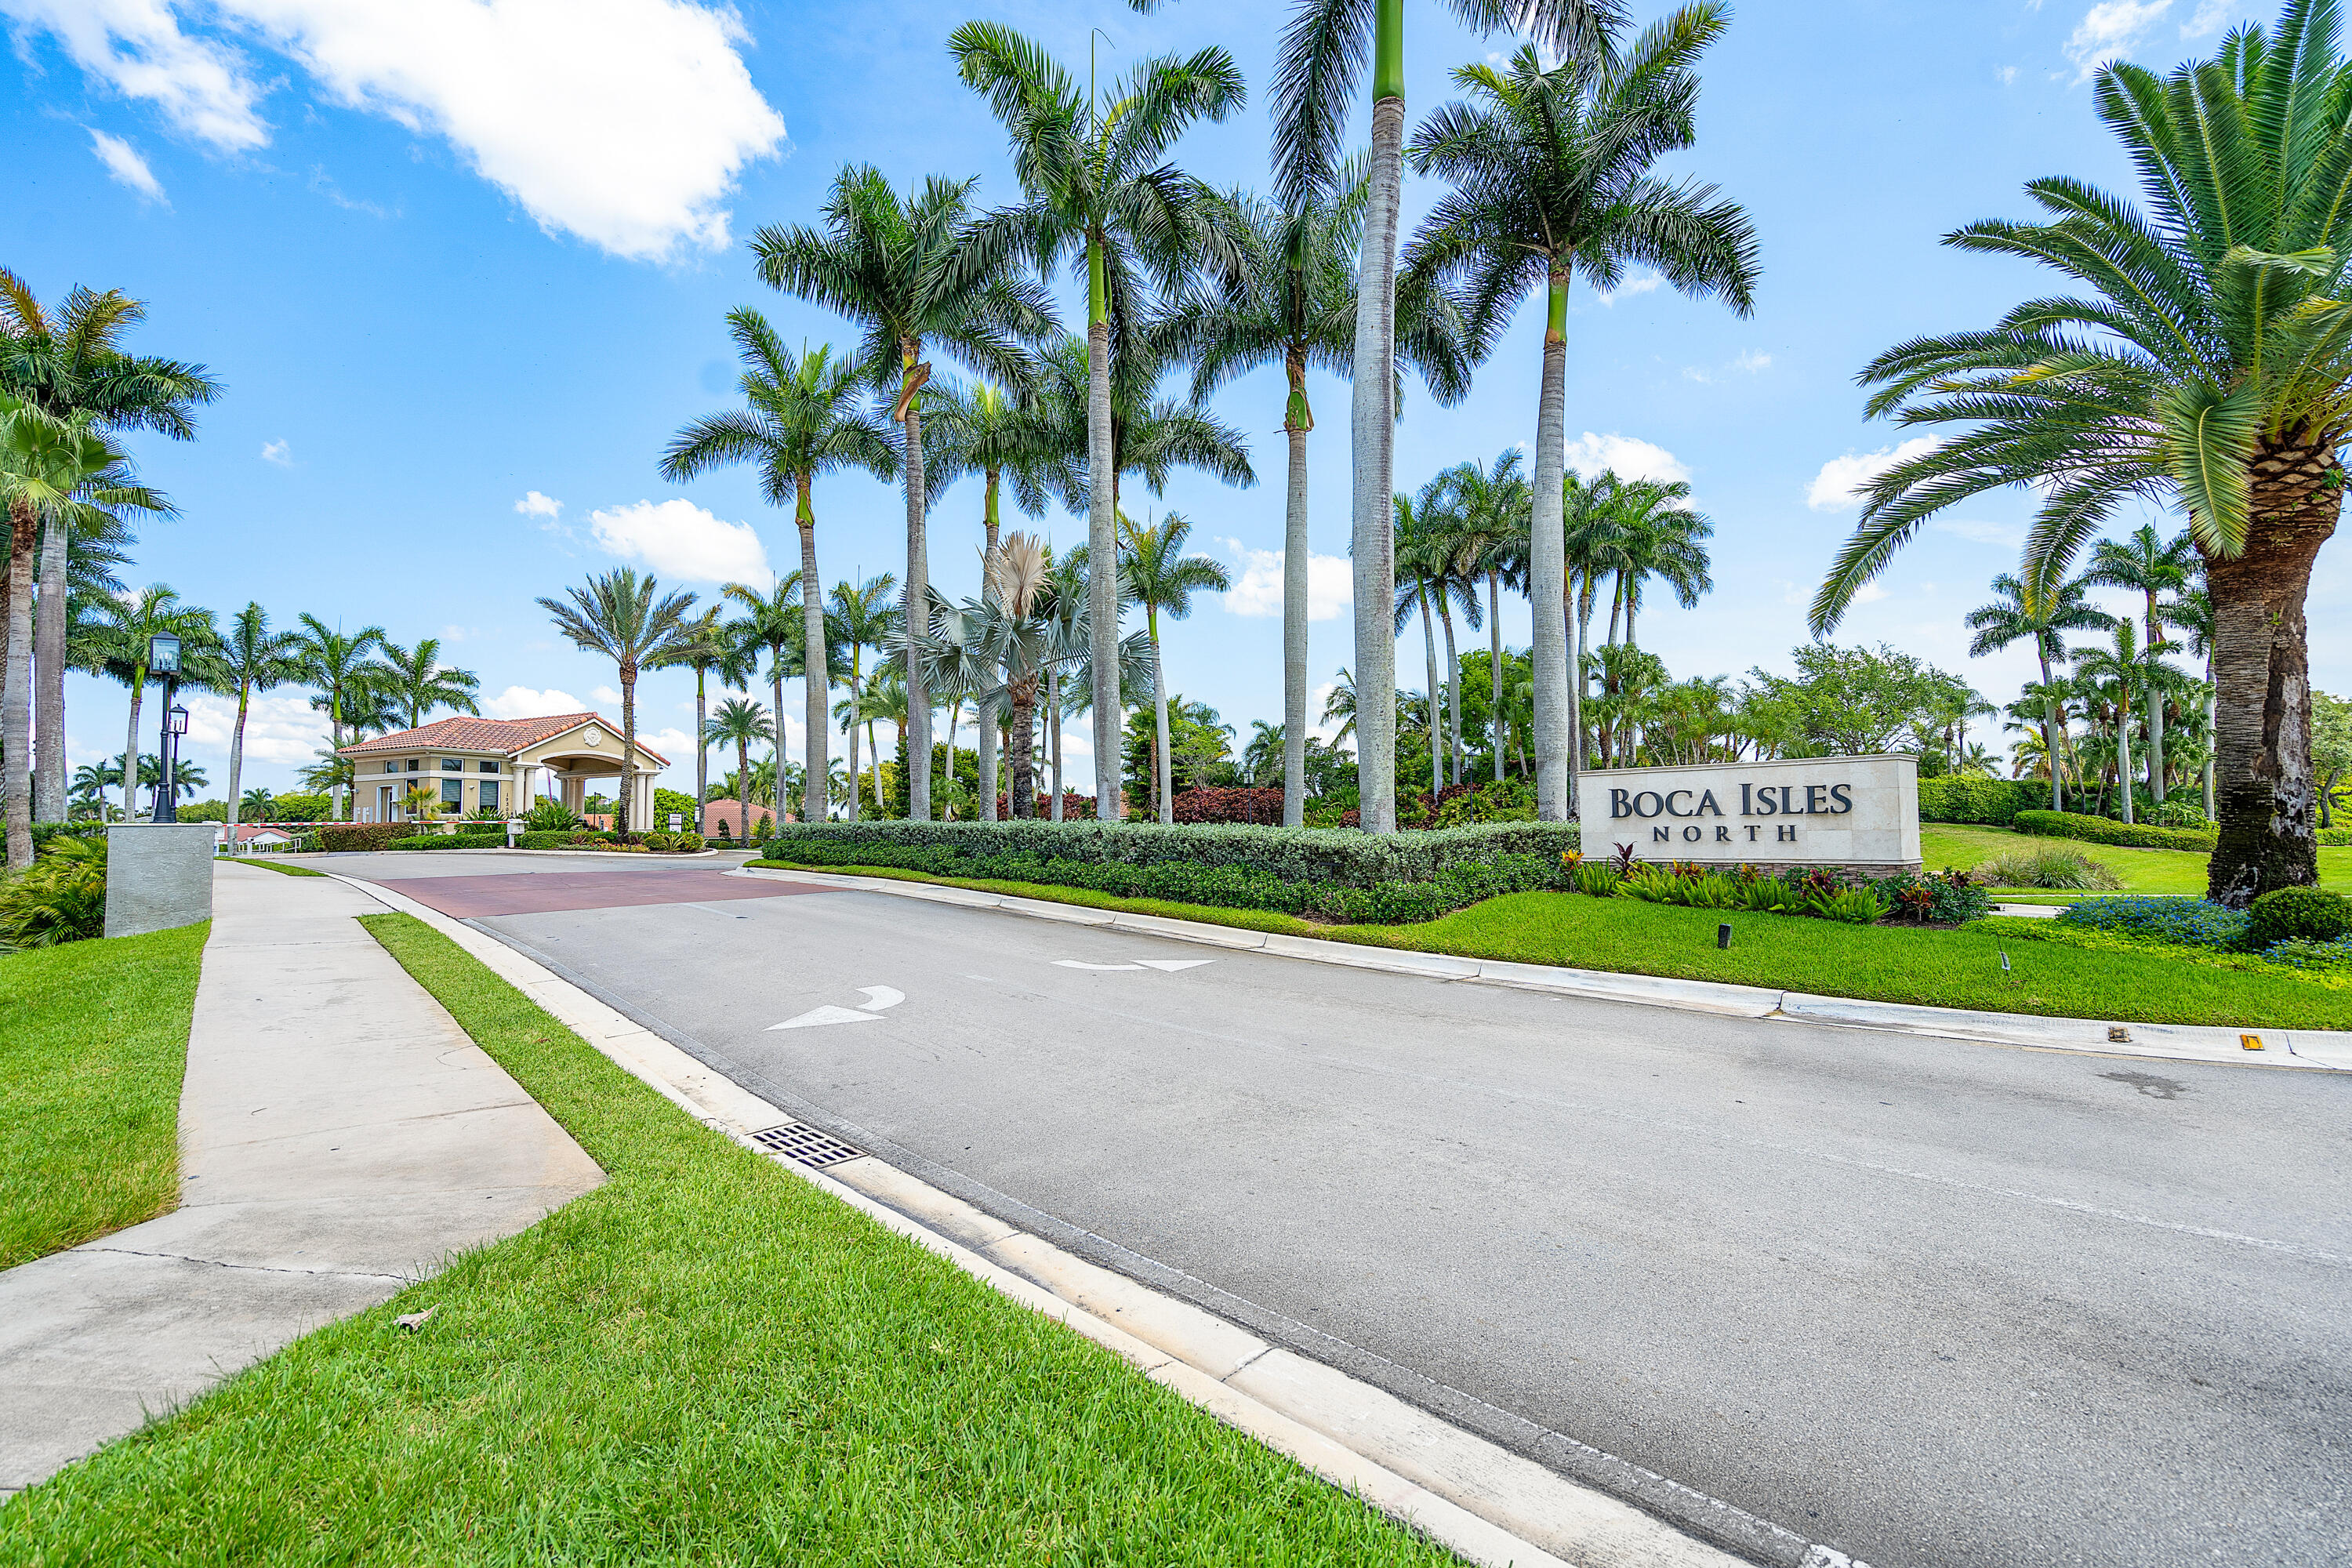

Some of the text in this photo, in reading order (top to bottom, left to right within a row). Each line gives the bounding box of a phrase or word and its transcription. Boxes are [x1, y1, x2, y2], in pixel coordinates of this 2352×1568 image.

[1608, 782, 1853, 818] BOCA ISLES
[1652, 824, 1798, 843] NORTH
